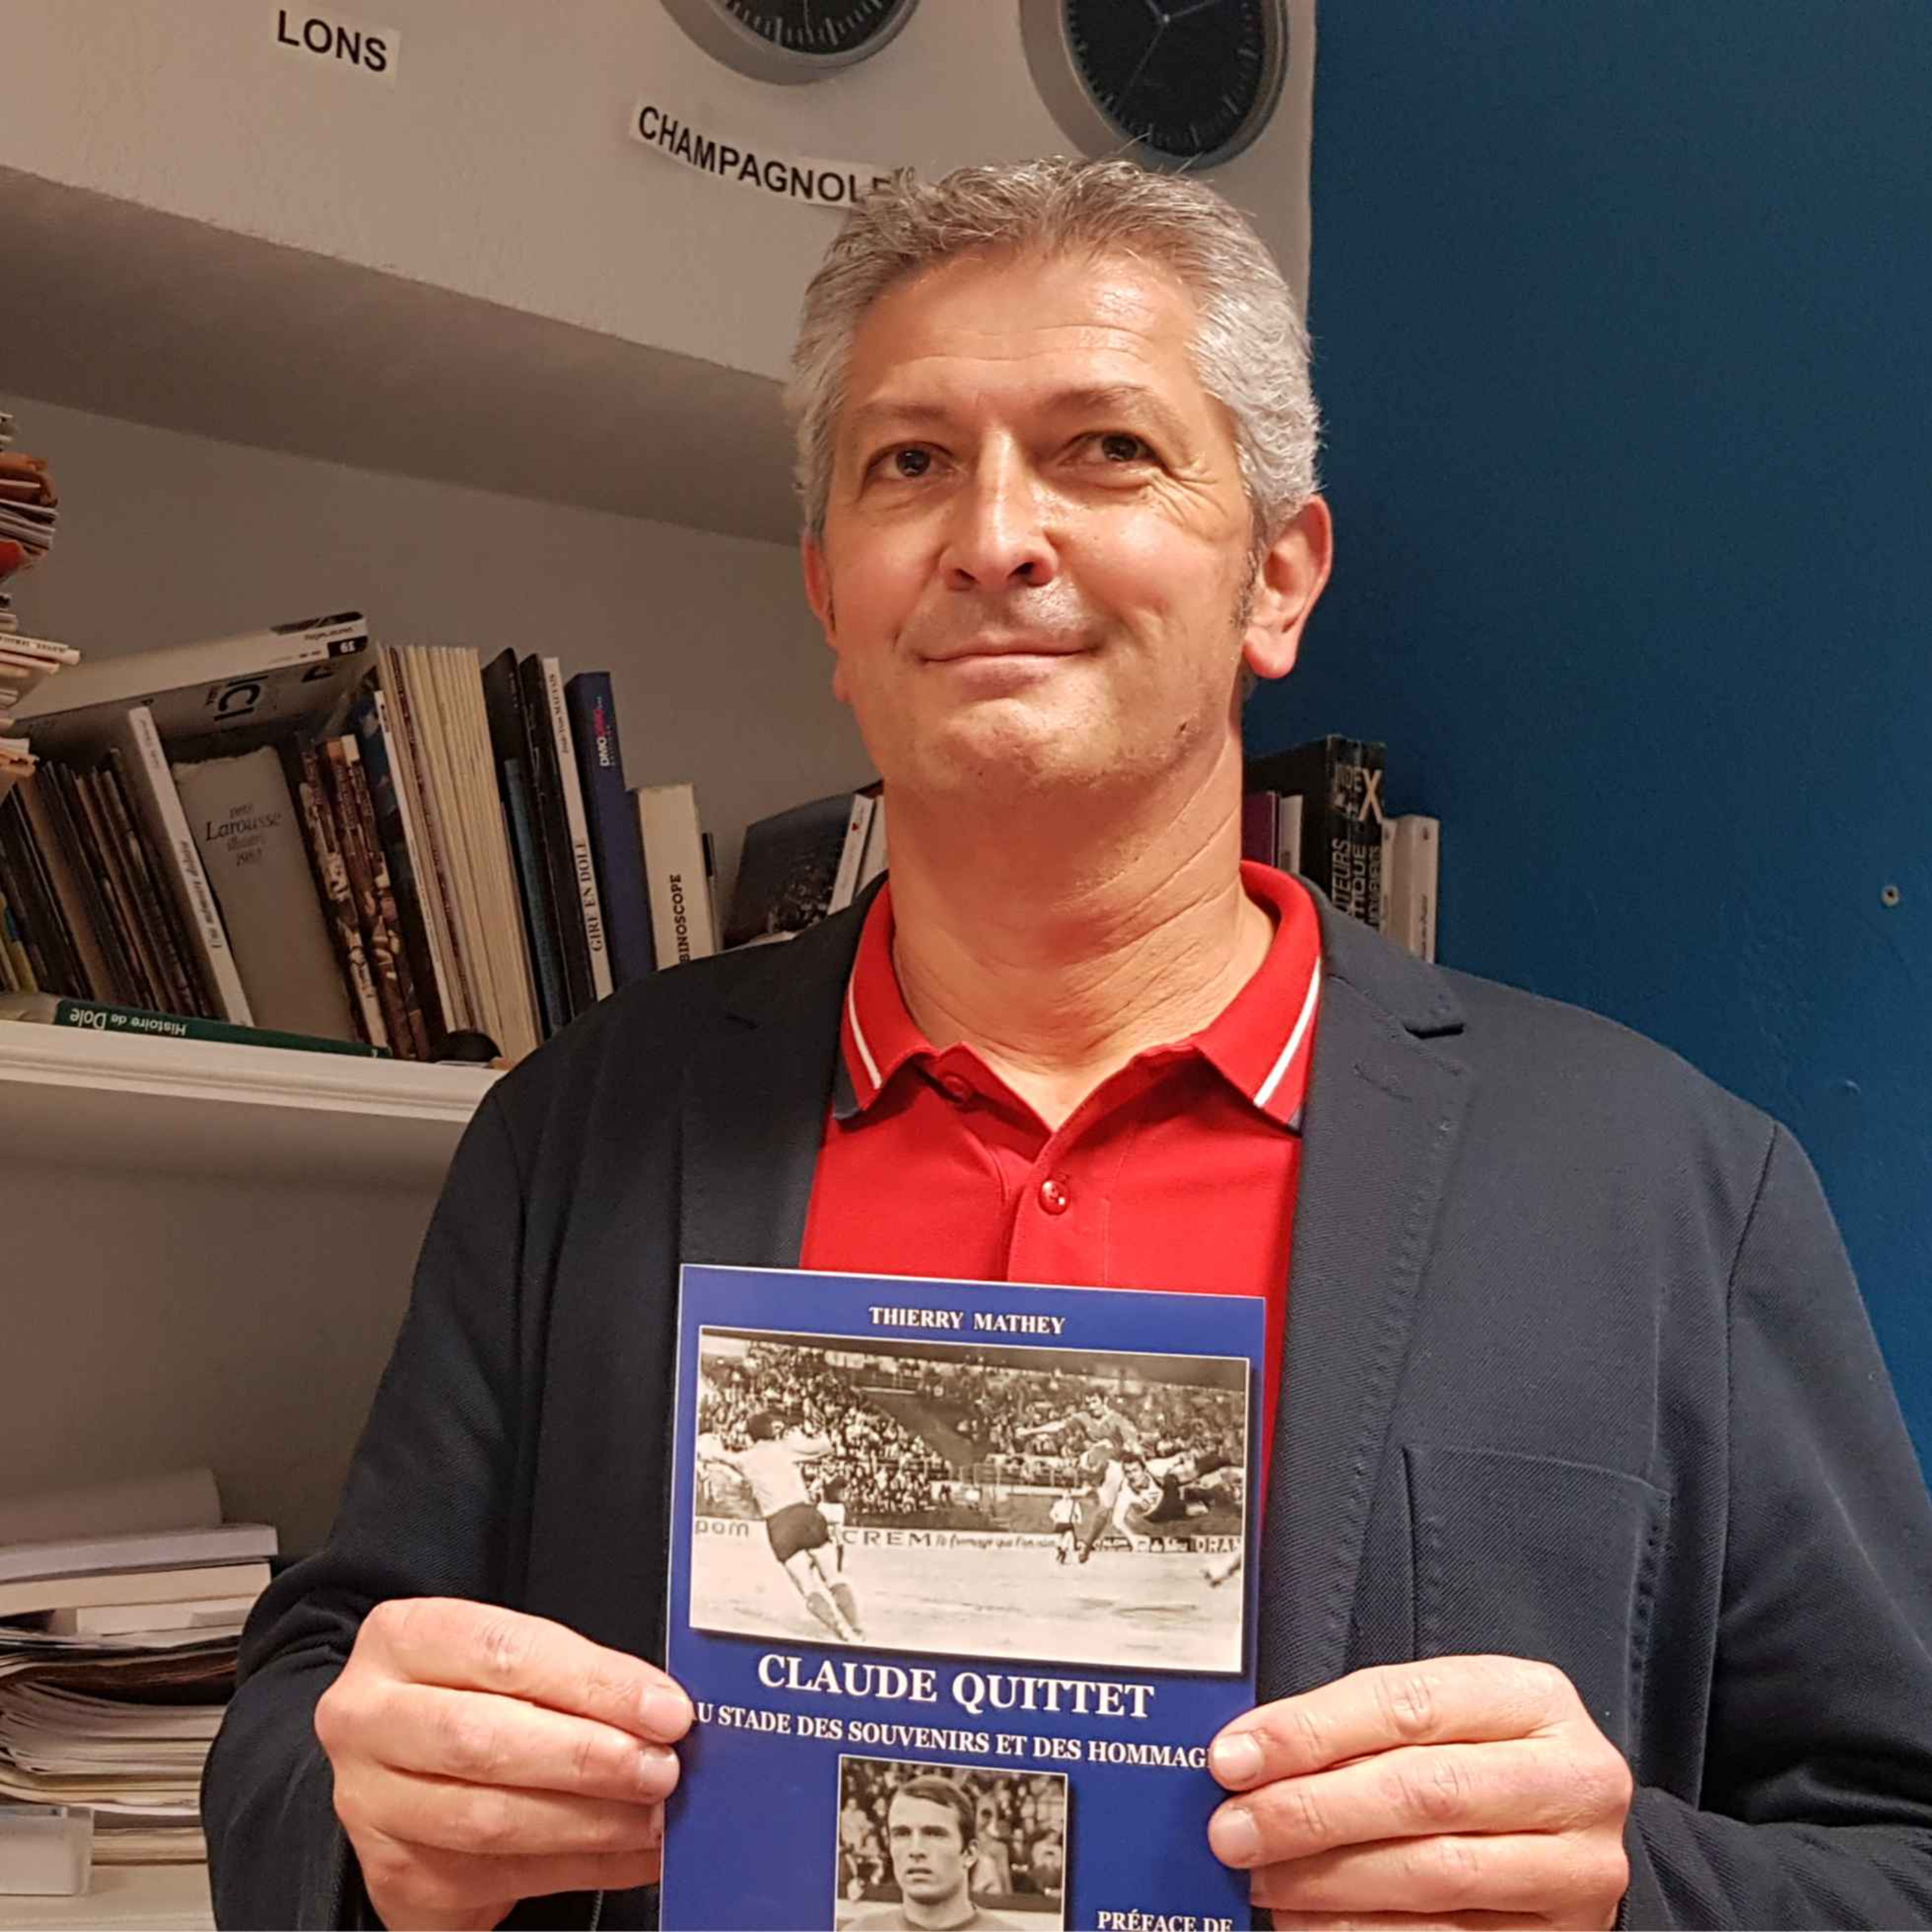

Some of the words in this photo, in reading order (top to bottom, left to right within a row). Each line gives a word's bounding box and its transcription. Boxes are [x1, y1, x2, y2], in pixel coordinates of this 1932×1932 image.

[278, 10, 386, 72] LONS
[205, 812, 282, 841] Larousse
[670, 875, 691, 963] BINOSCOPE
[69, 1007, 108, 1030] Dole
[110, 1013, 128, 1026] de
[131, 1016, 187, 1036] Histoire
[869, 1306, 964, 1329] THIERRY
[973, 1312, 1065, 1335] MATHEY
[757, 1654, 938, 1702] CLAUDE
[952, 1672, 1155, 1718] QUITTET
[693, 1701, 714, 1723] U
[718, 1705, 791, 1734] STADE
[797, 1716, 844, 1739] DES
[848, 1719, 990, 1754] SOUVENIRS
[996, 1734, 1028, 1756] ET
[1032, 1737, 1083, 1761] DES
[1087, 1741, 1211, 1769] HOMMAG
[1096, 1908, 1196, 1932] PRÉFACE
[1202, 1917, 1234, 1932] DE
